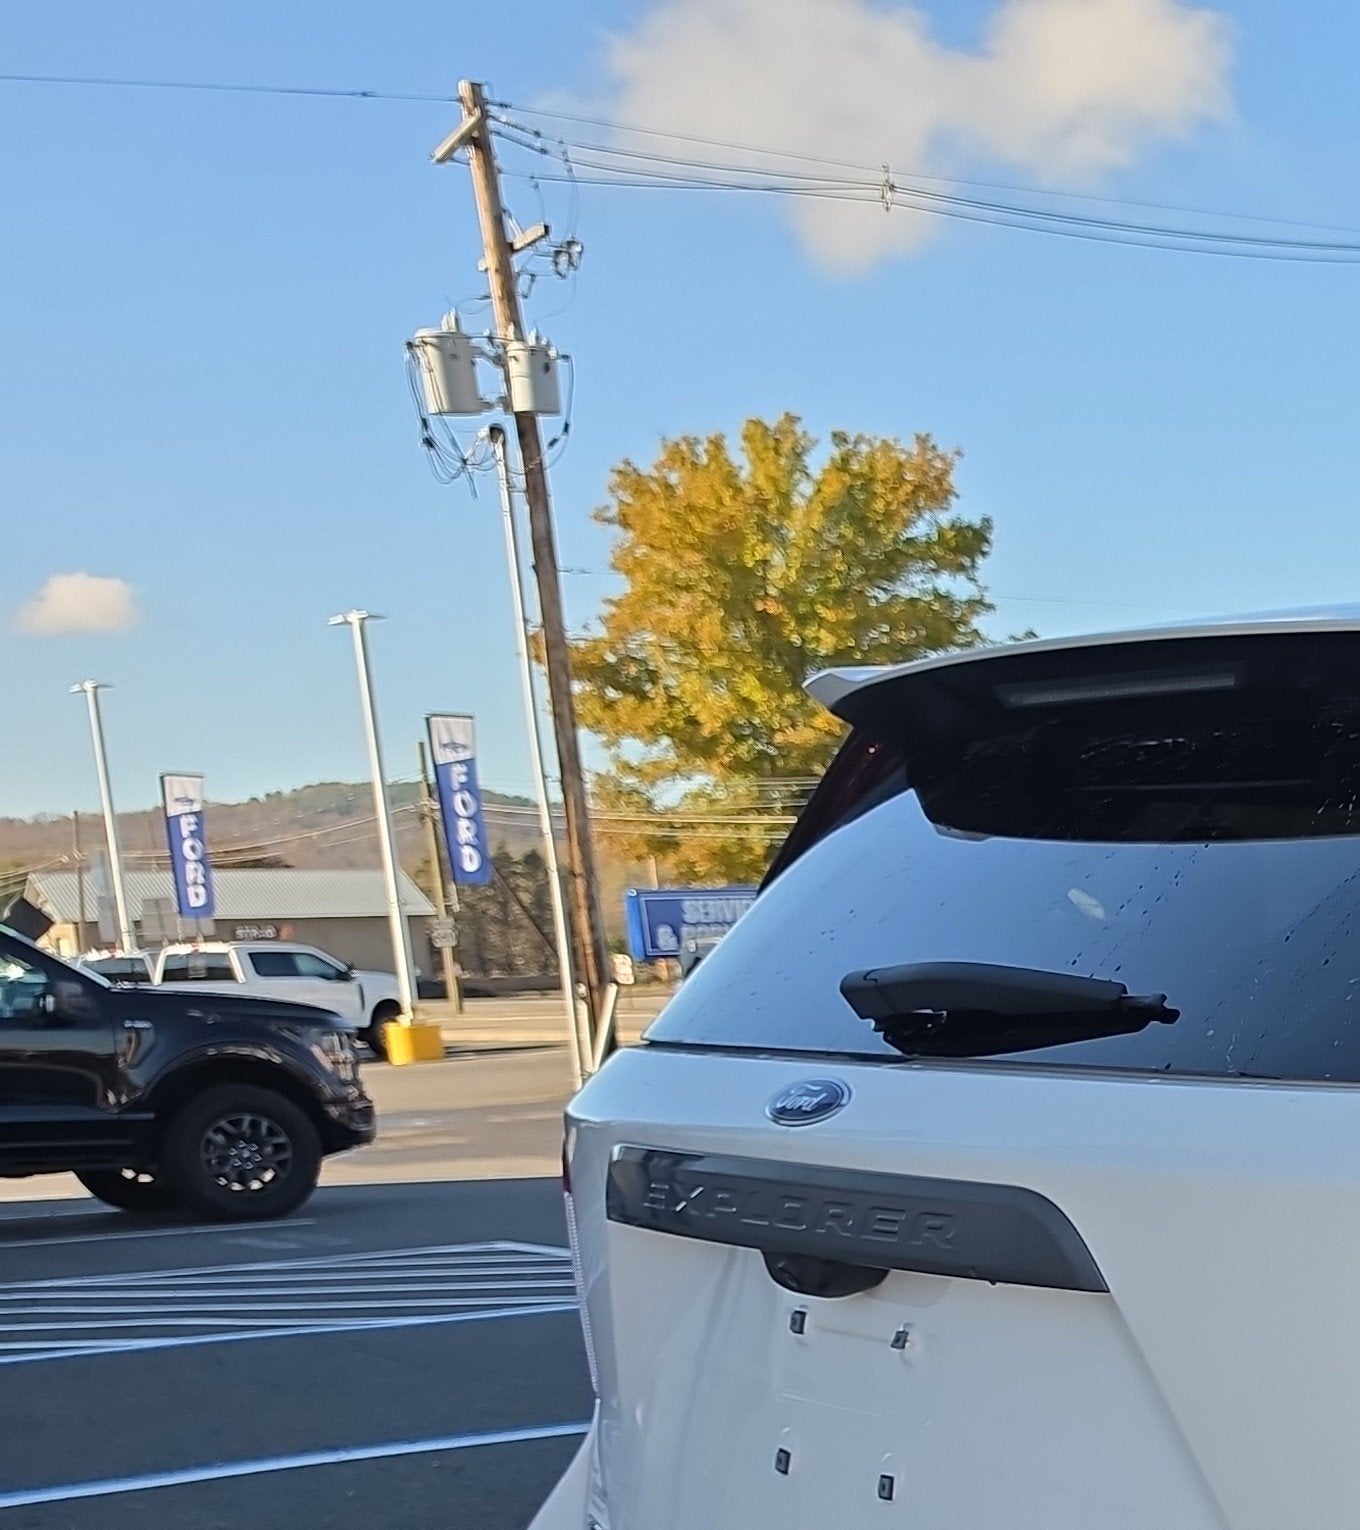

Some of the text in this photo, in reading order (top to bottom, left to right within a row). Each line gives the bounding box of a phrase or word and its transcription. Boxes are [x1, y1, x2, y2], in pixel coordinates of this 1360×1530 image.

[179, 813, 207, 909] FORD
[451, 762, 483, 873] FORD
[642, 1182, 956, 1250] EXPLORER
